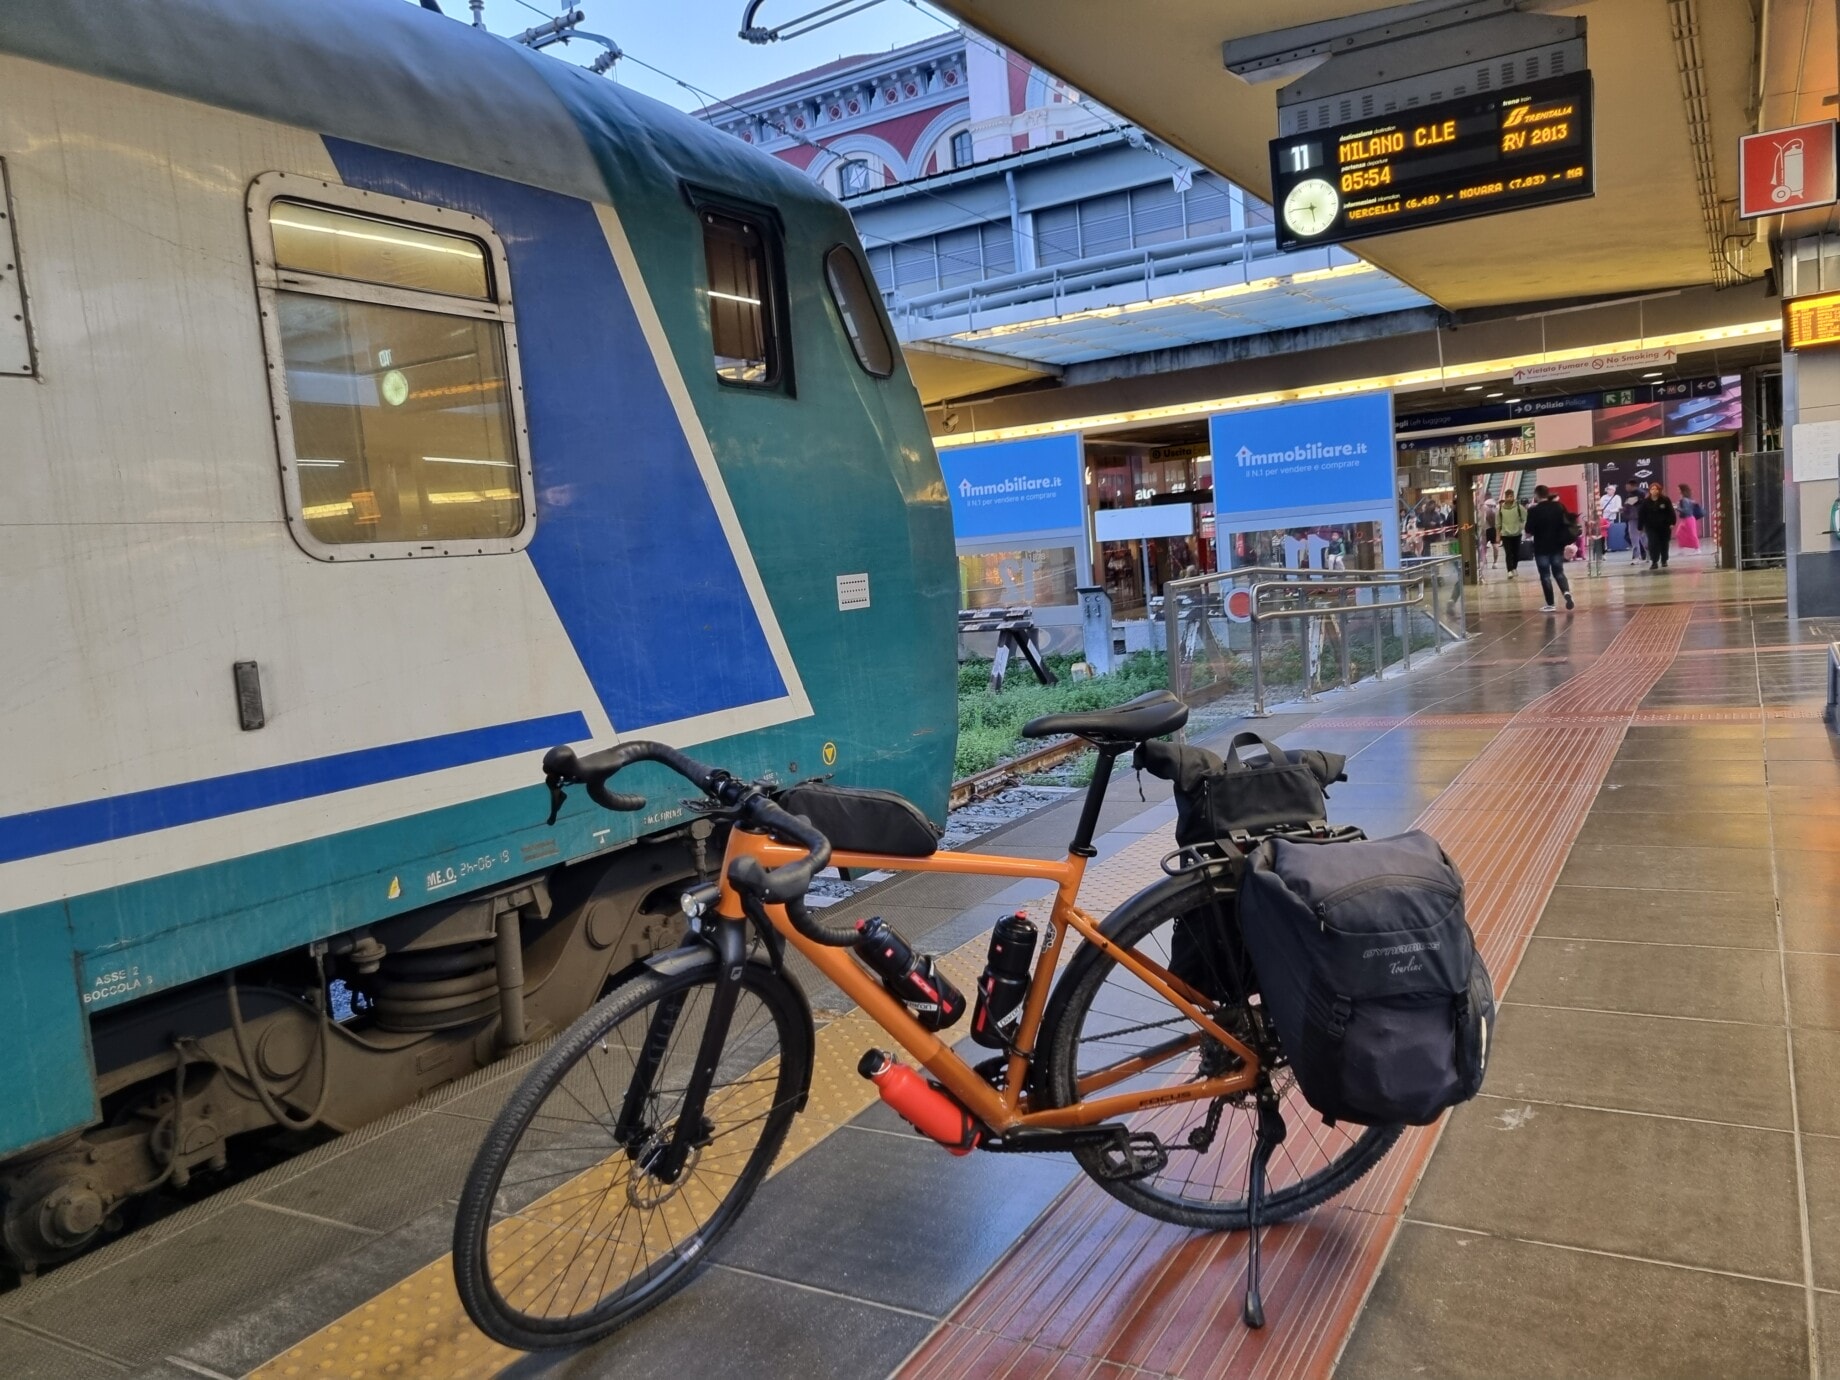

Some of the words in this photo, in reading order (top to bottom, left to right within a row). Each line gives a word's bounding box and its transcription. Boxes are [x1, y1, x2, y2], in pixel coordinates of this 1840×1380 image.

[1523, 105, 1573, 123] TRENITALIA
[1339, 132, 1404, 163] MILANO
[1414, 121, 1456, 146] C.LE
[1502, 130, 1526, 152] RV
[1531, 123, 1568, 146] 2013
[1291, 143, 1310, 173] 11
[1341, 166, 1391, 192] 05:54
[1348, 202, 1400, 220] VERCELLI
[1405, 195, 1440, 210] (6.48)
[1459, 182, 1503, 199] NOVARA
[1509, 174, 1546, 190] (7.03)
[1527, 362, 1556, 375] Vietato
[1558, 361, 1589, 371] Fumare
[1606, 356, 1619, 364] No
[1621, 351, 1660, 362] Smoking
[1535, 401, 1564, 411] Polizia
[1164, 449, 1192, 458] Uscita
[1235, 442, 1367, 467] immobiliare.it
[1252, 469, 1264, 477] N.1
[1265, 468, 1278, 478] per
[1280, 464, 1312, 475] vendere
[1321, 459, 1360, 471] comprare
[959, 476, 1062, 498] immobiliare.it
[982, 498, 992, 507] per
[993, 496, 1019, 504] vendere
[1026, 492, 1057, 502] comprare
[96, 970, 126, 986] ASSE
[133, 966, 139, 976] 2
[83, 979, 142, 1003] BOCCOLA
[1139, 1091, 1191, 1106] FOCUS
